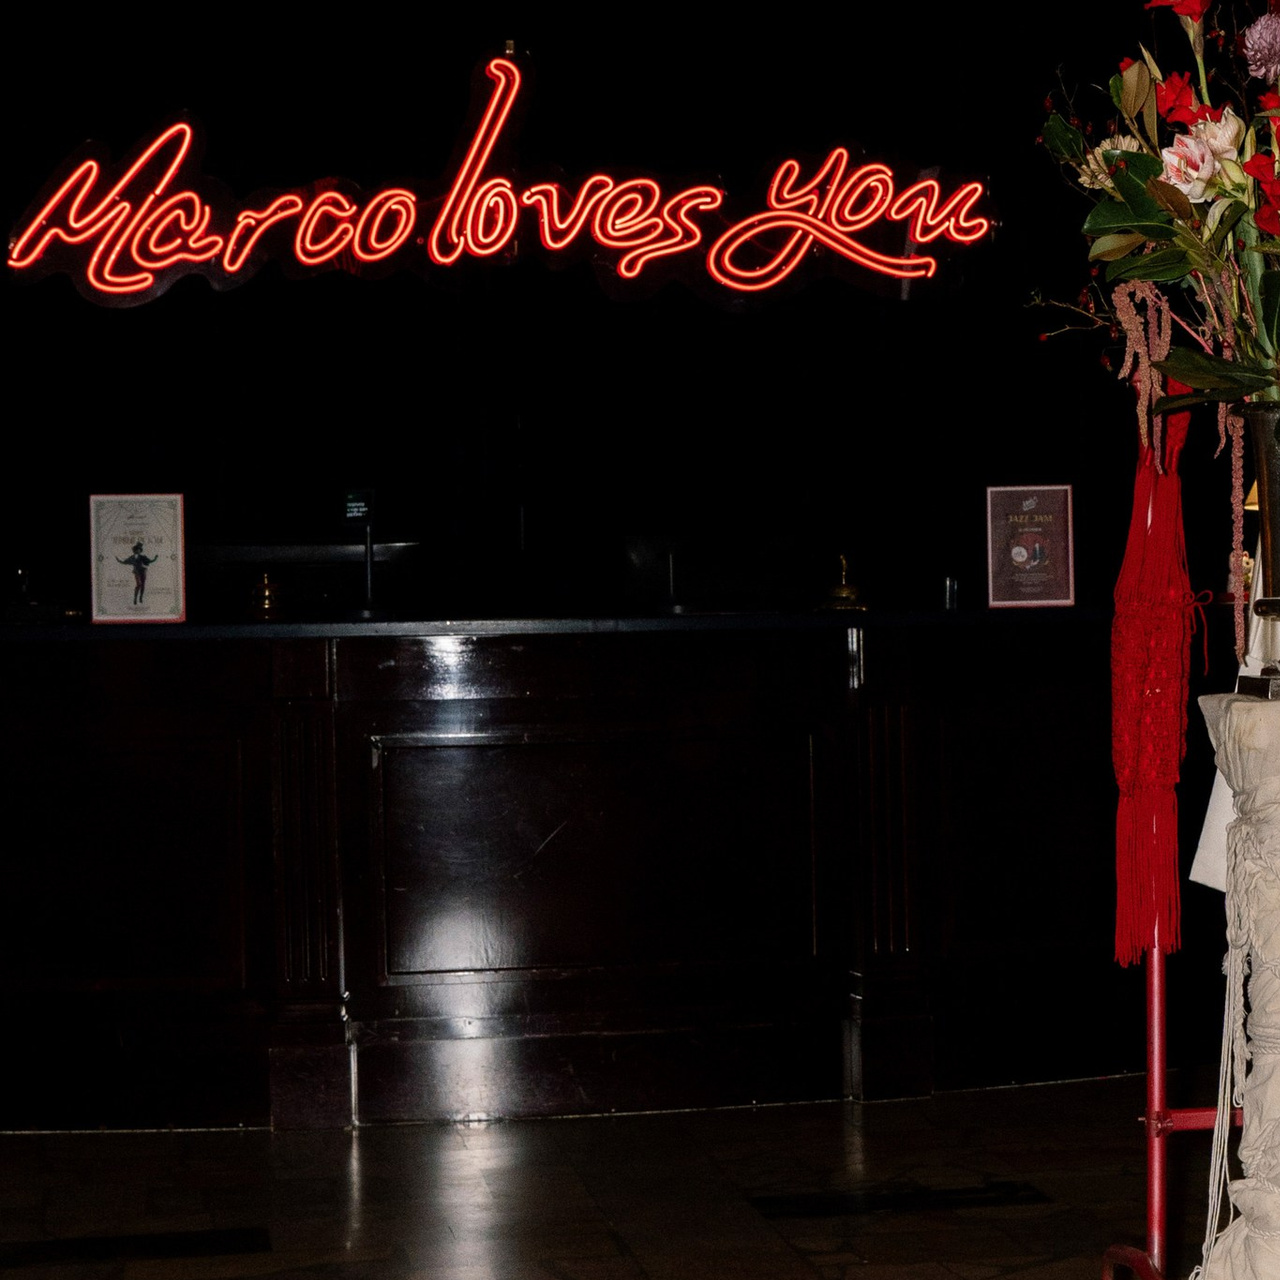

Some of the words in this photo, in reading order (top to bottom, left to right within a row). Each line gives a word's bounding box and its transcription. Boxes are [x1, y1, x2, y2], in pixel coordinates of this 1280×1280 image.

[8, 122, 416, 293] Marco
[428, 58, 723, 278] loves
[707, 147, 993, 292] you
